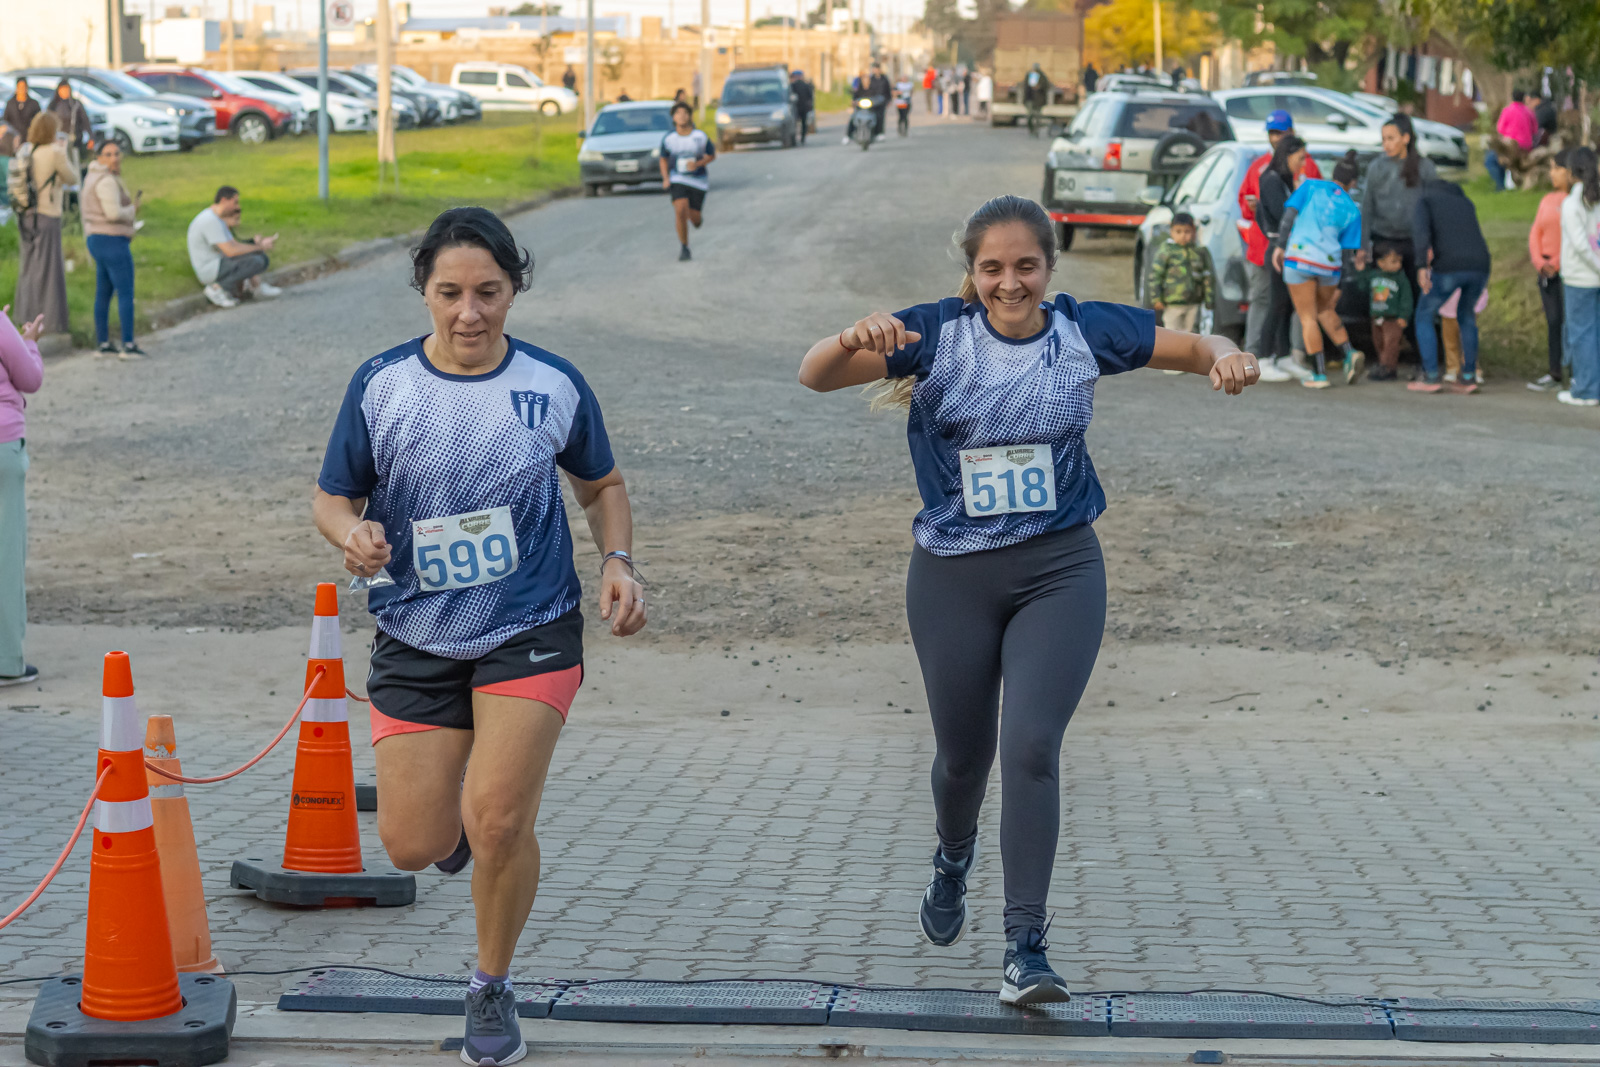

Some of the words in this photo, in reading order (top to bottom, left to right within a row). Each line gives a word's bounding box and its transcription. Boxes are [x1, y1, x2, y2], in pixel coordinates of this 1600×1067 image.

[518, 393, 544, 404] SFC
[971, 467, 1049, 513] 518
[417, 533, 513, 588] 599
[300, 796, 342, 805] CONOFLEX
